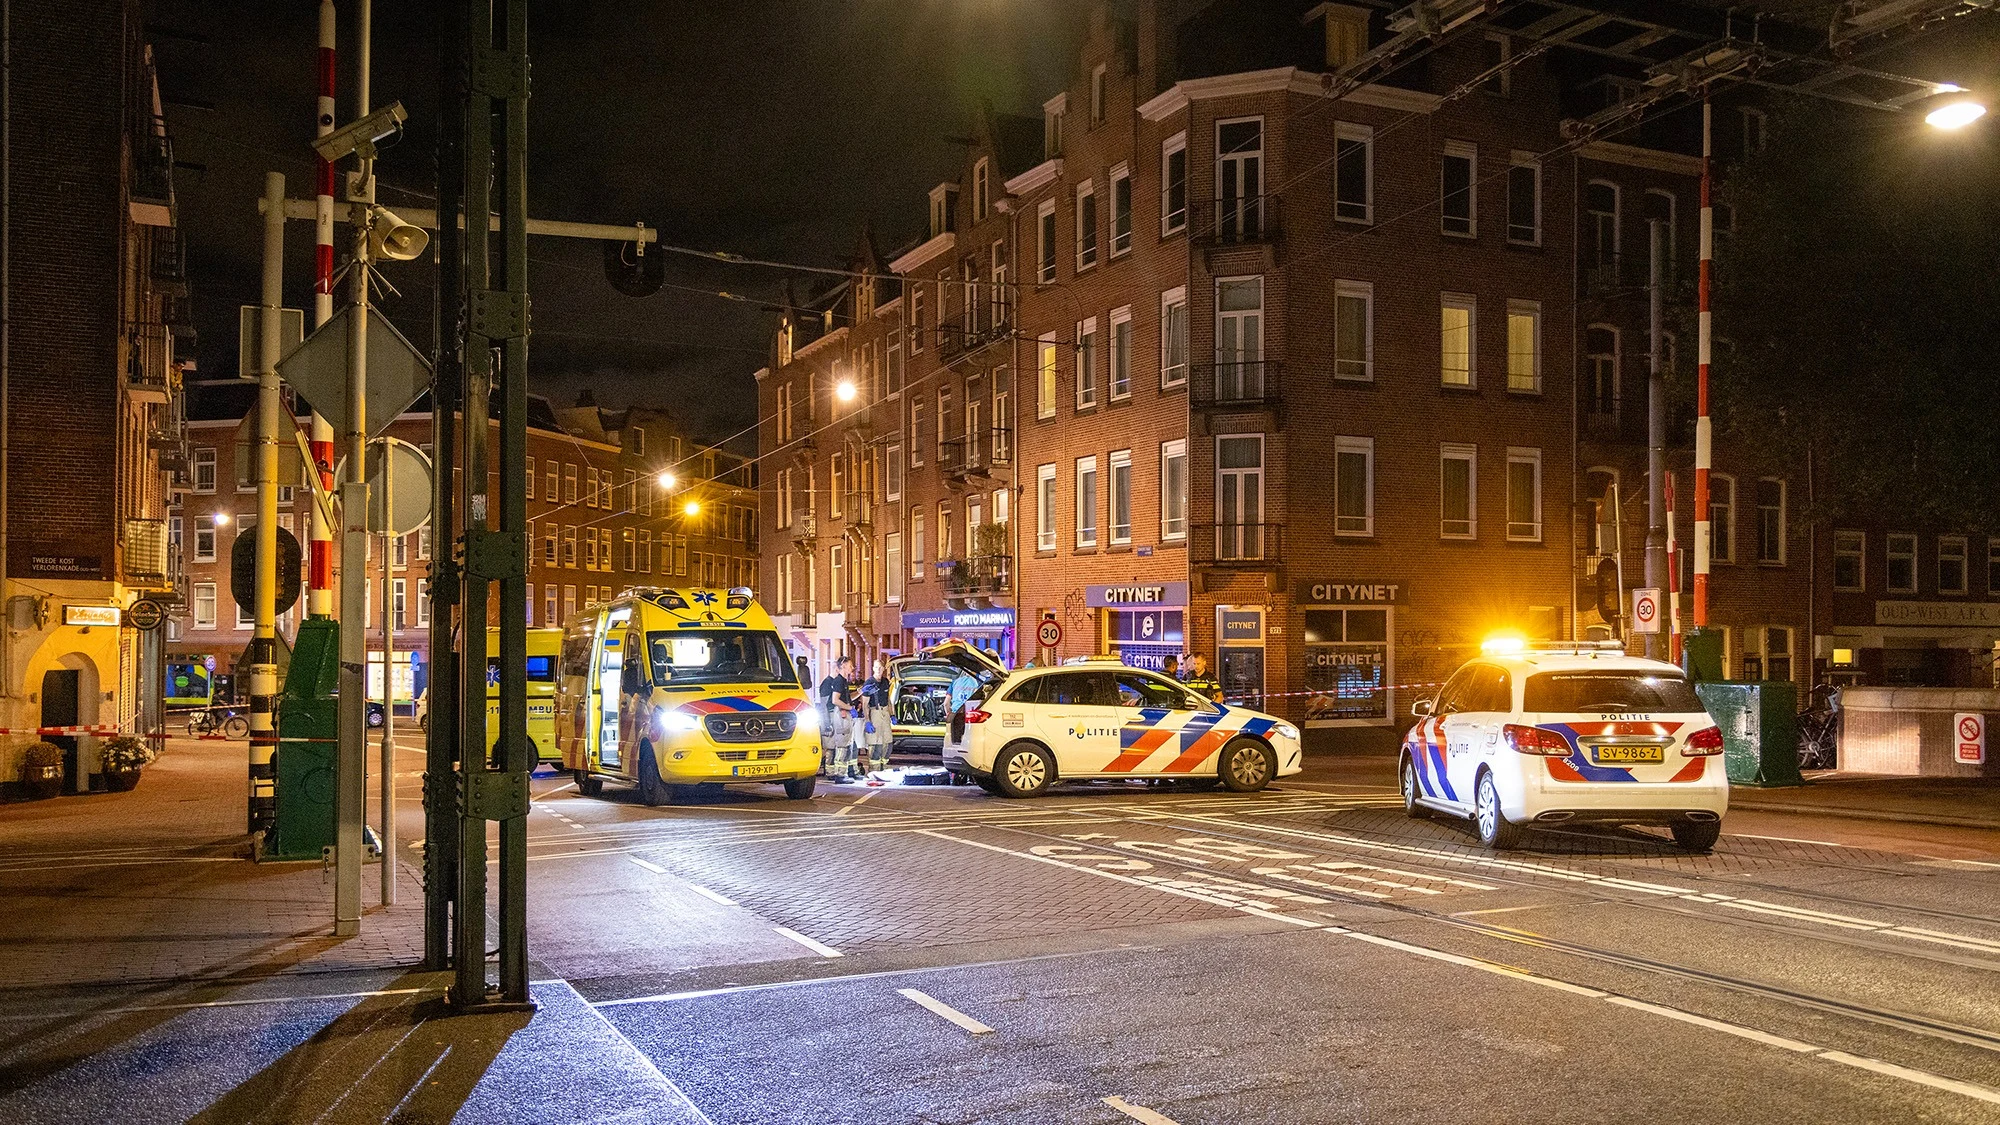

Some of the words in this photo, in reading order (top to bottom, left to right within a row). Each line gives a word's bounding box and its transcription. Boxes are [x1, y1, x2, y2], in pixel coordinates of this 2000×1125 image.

[32, 564, 80, 572] VERLORENKADE
[1105, 586, 1162, 603] CITYNET
[1311, 584, 1399, 600] CITYNET
[1640, 605, 1652, 615] 30
[1881, 605, 1950, 620] OUD-WEST
[953, 614, 979, 626] PORTO
[979, 613, 1009, 625] MARINA
[1227, 621, 1257, 629] CITYNET
[1041, 628, 1058, 640] 30
[1316, 653, 1372, 666] CITYNET
[1068, 727, 1118, 739] POLITIE
[1449, 743, 1469, 757] POLITIE
[1602, 747, 1658, 759] SV-986-Z
[741, 766, 774, 775] J-129-XP
